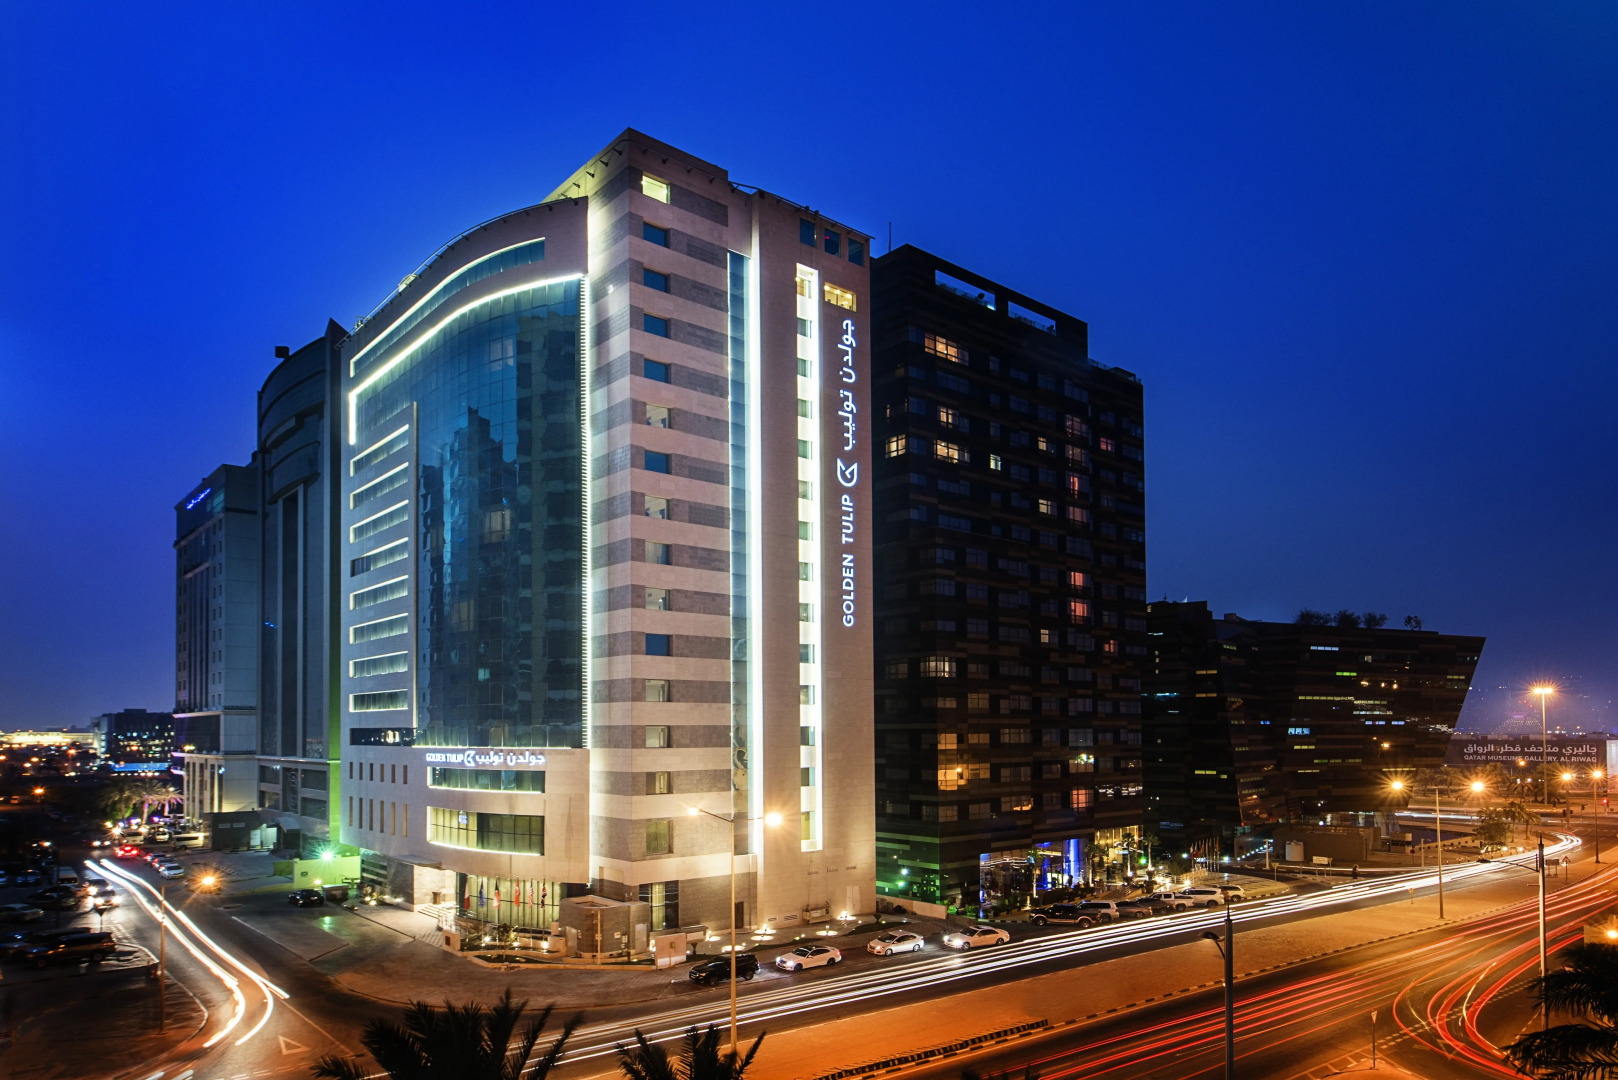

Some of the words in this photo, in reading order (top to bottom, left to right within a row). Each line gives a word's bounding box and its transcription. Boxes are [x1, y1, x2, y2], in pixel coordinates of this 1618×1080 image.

[837, 319, 857, 383] جولدن
[837, 389, 857, 451] توليب
[842, 494, 855, 544] TULIP
[842, 554, 855, 627] GOLDEN
[446, 753, 464, 763] TULIP
[475, 751, 504, 766] توليب
[506, 751, 546, 766] جولدن
[1525, 744, 1559, 753] متحف
